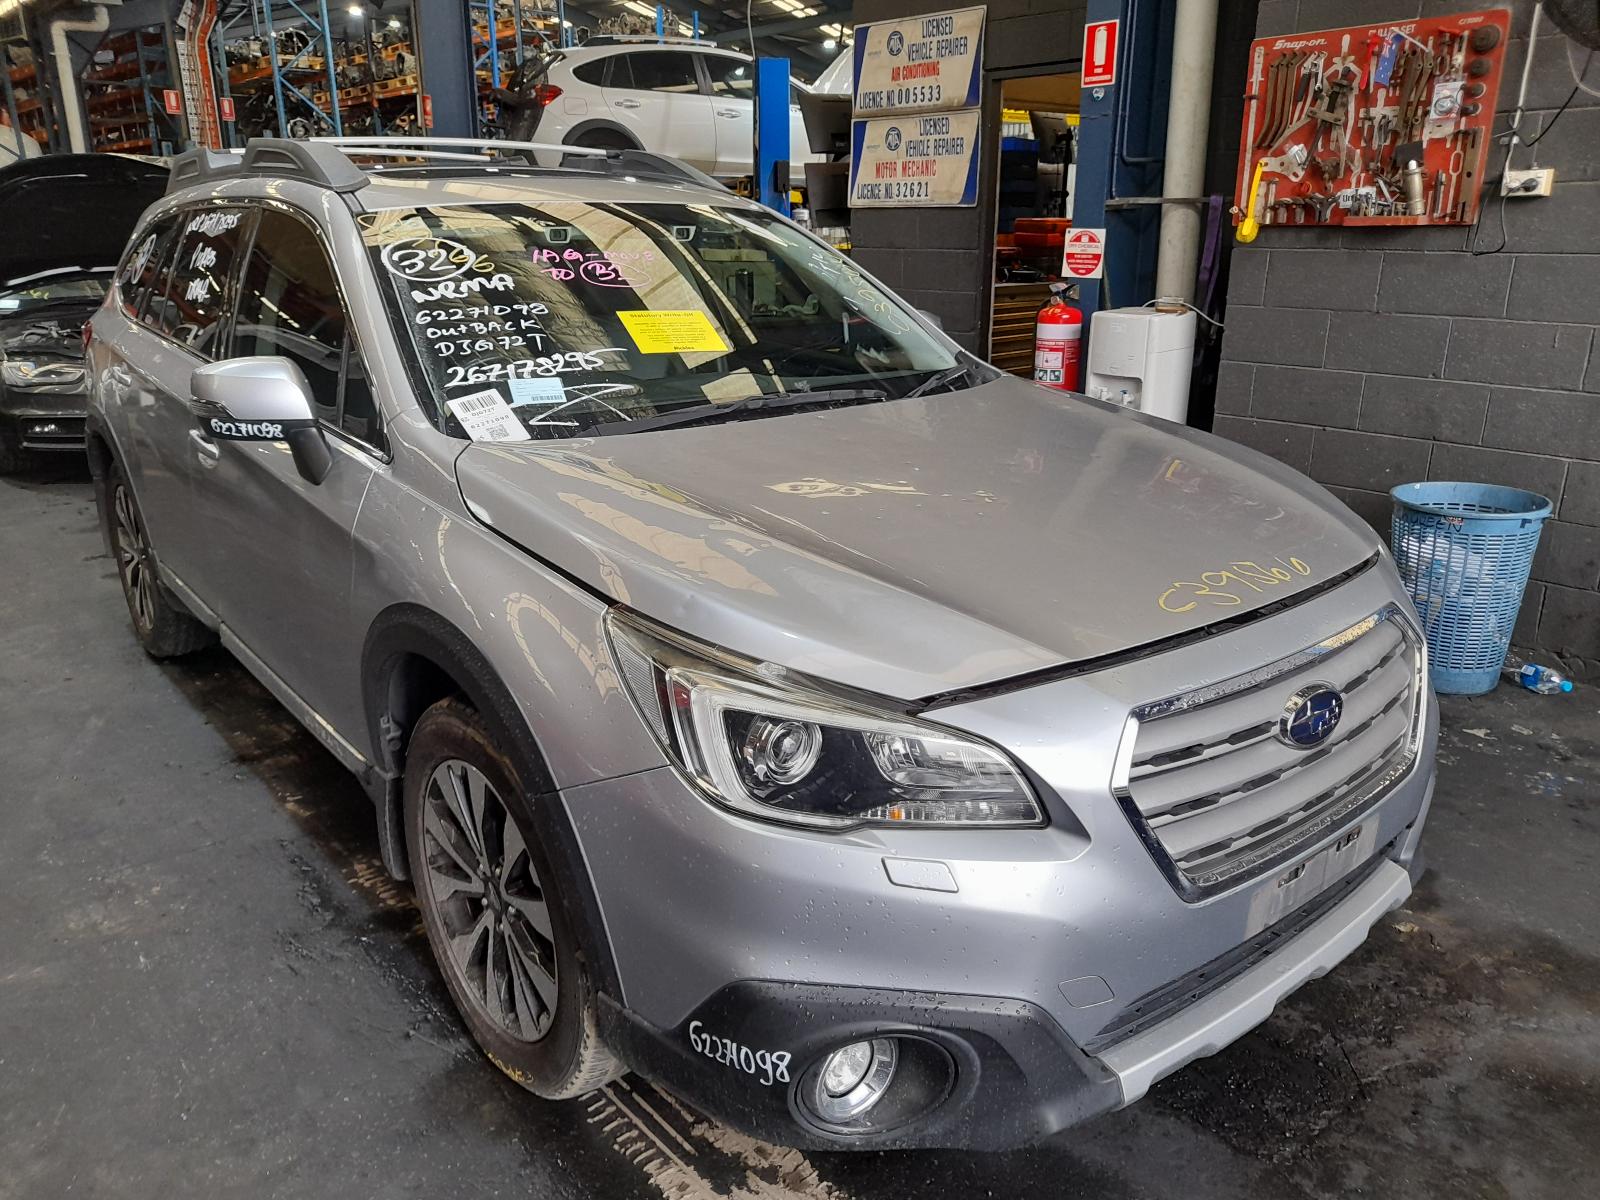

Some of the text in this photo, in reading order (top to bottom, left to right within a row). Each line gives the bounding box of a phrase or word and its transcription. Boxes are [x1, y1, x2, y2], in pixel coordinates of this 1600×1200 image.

[921, 16, 954, 39] LICENSED
[1400, 24, 1417, 35] SET
[907, 36, 968, 62] VEHICLE REPAIRER
[1272, 38, 1328, 51] Snap-on
[891, 60, 940, 82] AIR CONDITIONING
[859, 90, 883, 110] LICENCE
[919, 117, 950, 137] LICENSED
[905, 137, 964, 158] VEHICLE REPAIRER
[875, 159, 937, 179] MOTOR MECHANIC
[857, 183, 881, 200] LICENCE
[415, 302, 549, 325] 62271098
[210, 418, 285, 439] 62271098
[689, 1020, 792, 1086] 62271098
